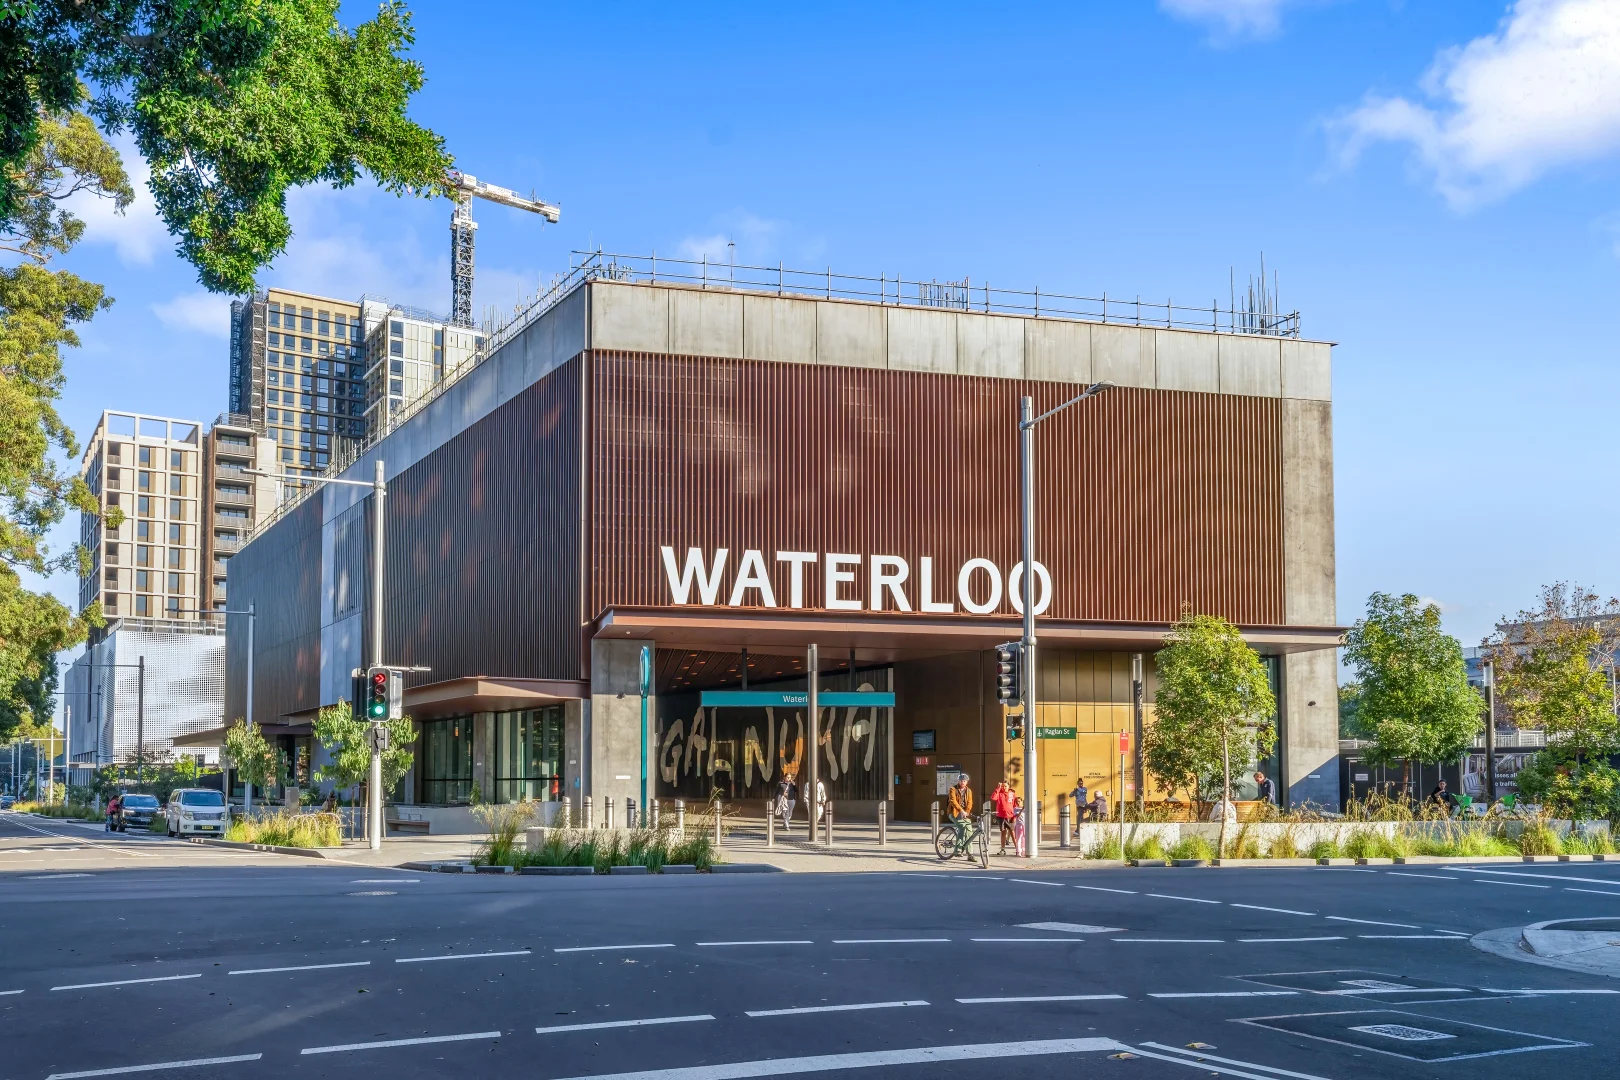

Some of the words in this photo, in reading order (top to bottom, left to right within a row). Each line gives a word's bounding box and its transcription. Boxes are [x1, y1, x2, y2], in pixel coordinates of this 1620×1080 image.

[660, 545, 1053, 616] WATERLOO
[782, 695, 808, 703] Waterl
[1044, 728, 1063, 736] Raglan
